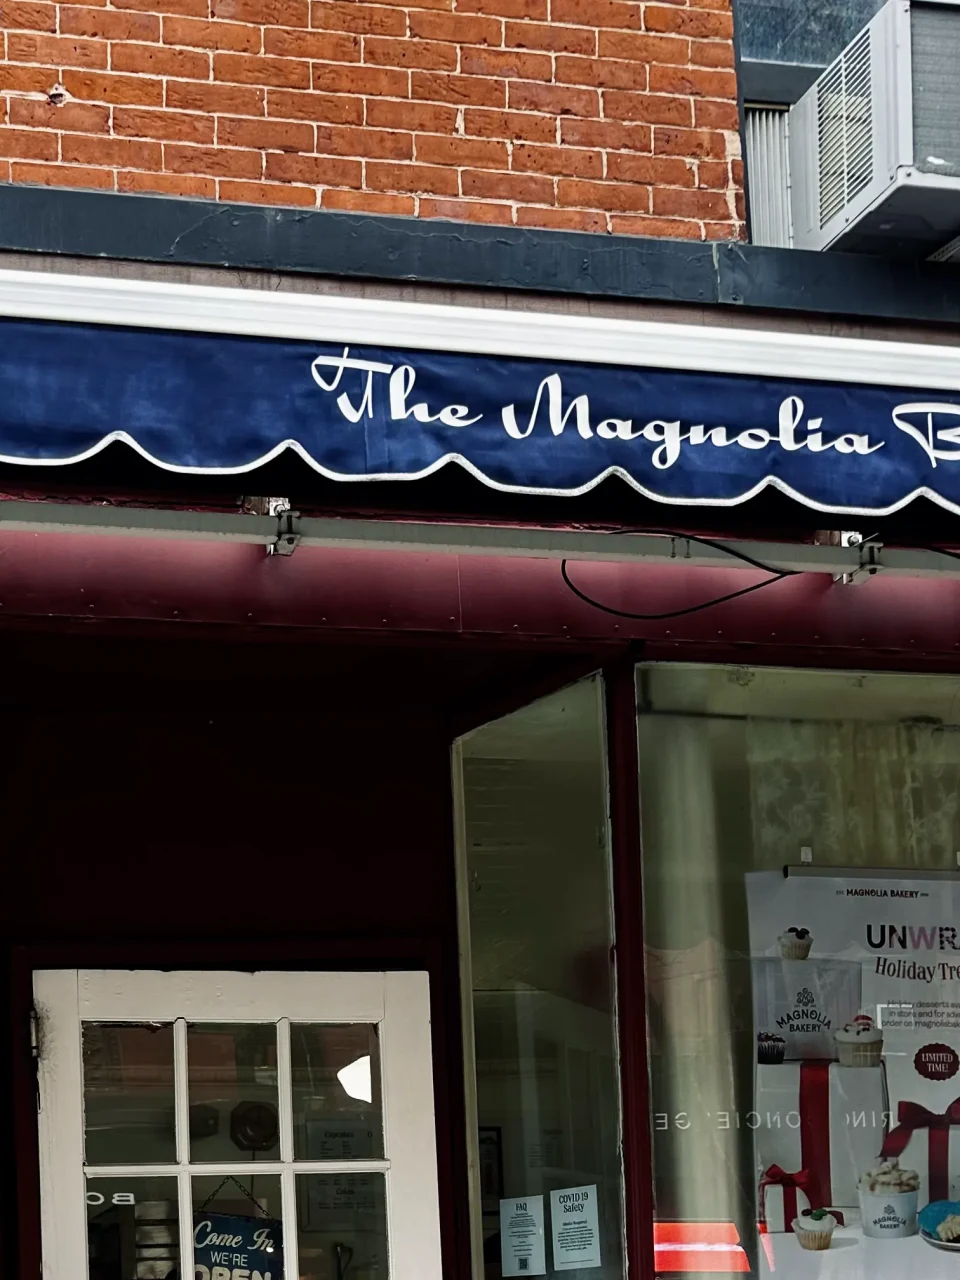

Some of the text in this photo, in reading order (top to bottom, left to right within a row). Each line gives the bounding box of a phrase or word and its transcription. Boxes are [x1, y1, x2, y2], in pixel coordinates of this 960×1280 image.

[311, 346, 483, 427] The
[501, 372, 885, 470] Magnolia
[846, 888, 889, 898] MAGNOLIA
[890, 889, 920, 899] BAKERY
[866, 924, 960, 951] UNWR
[875, 956, 937, 984] Holiday
[775, 1008, 832, 1030] MAGNOLIA
[789, 1023, 822, 1033] BAKERY
[921, 1052, 954, 1063] LIMITED
[927, 1062, 949, 1073] TIME!
[558, 1191, 589, 1205] COVID 19
[515, 1202, 528, 1212] FAQ
[563, 1203, 585, 1214] Safety
[872, 1215, 907, 1226] MAGNOLIA
[193, 1220, 276, 1253] Come In
[210, 1250, 249, 1267] WE'RE
